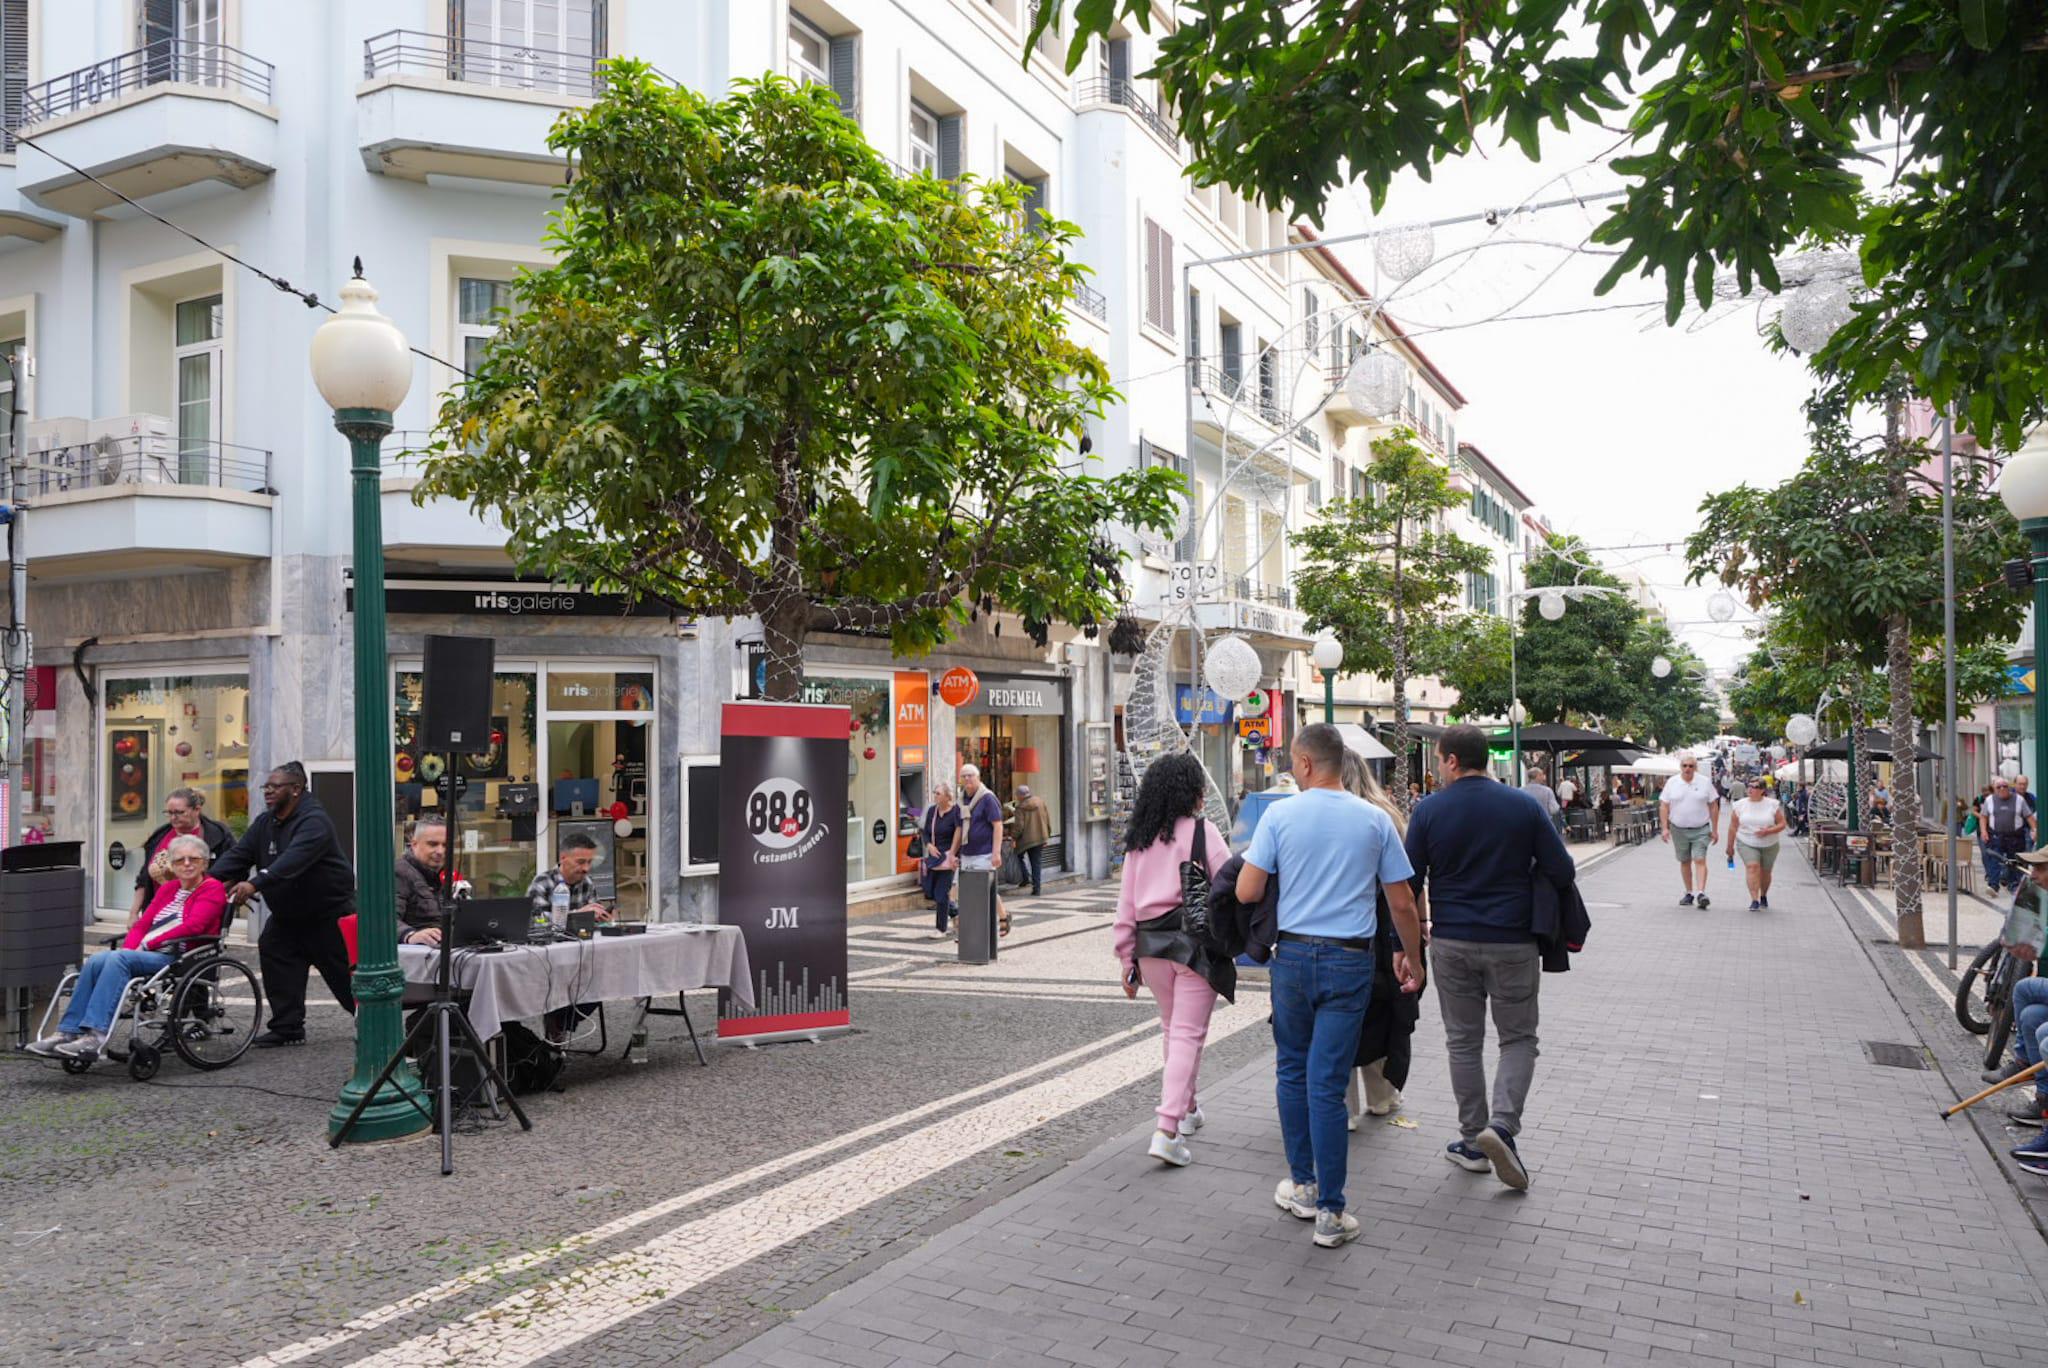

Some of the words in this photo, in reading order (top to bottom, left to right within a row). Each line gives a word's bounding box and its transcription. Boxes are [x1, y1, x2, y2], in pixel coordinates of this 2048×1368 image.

[1176, 586, 1211, 599] SL
[475, 591, 575, 614] irisgalerie
[943, 675, 969, 688] ATM
[988, 688, 1043, 708] PEDEMEIA
[898, 703, 926, 721] ATM
[1244, 720, 1265, 728] ATM
[765, 907, 800, 929] JM
